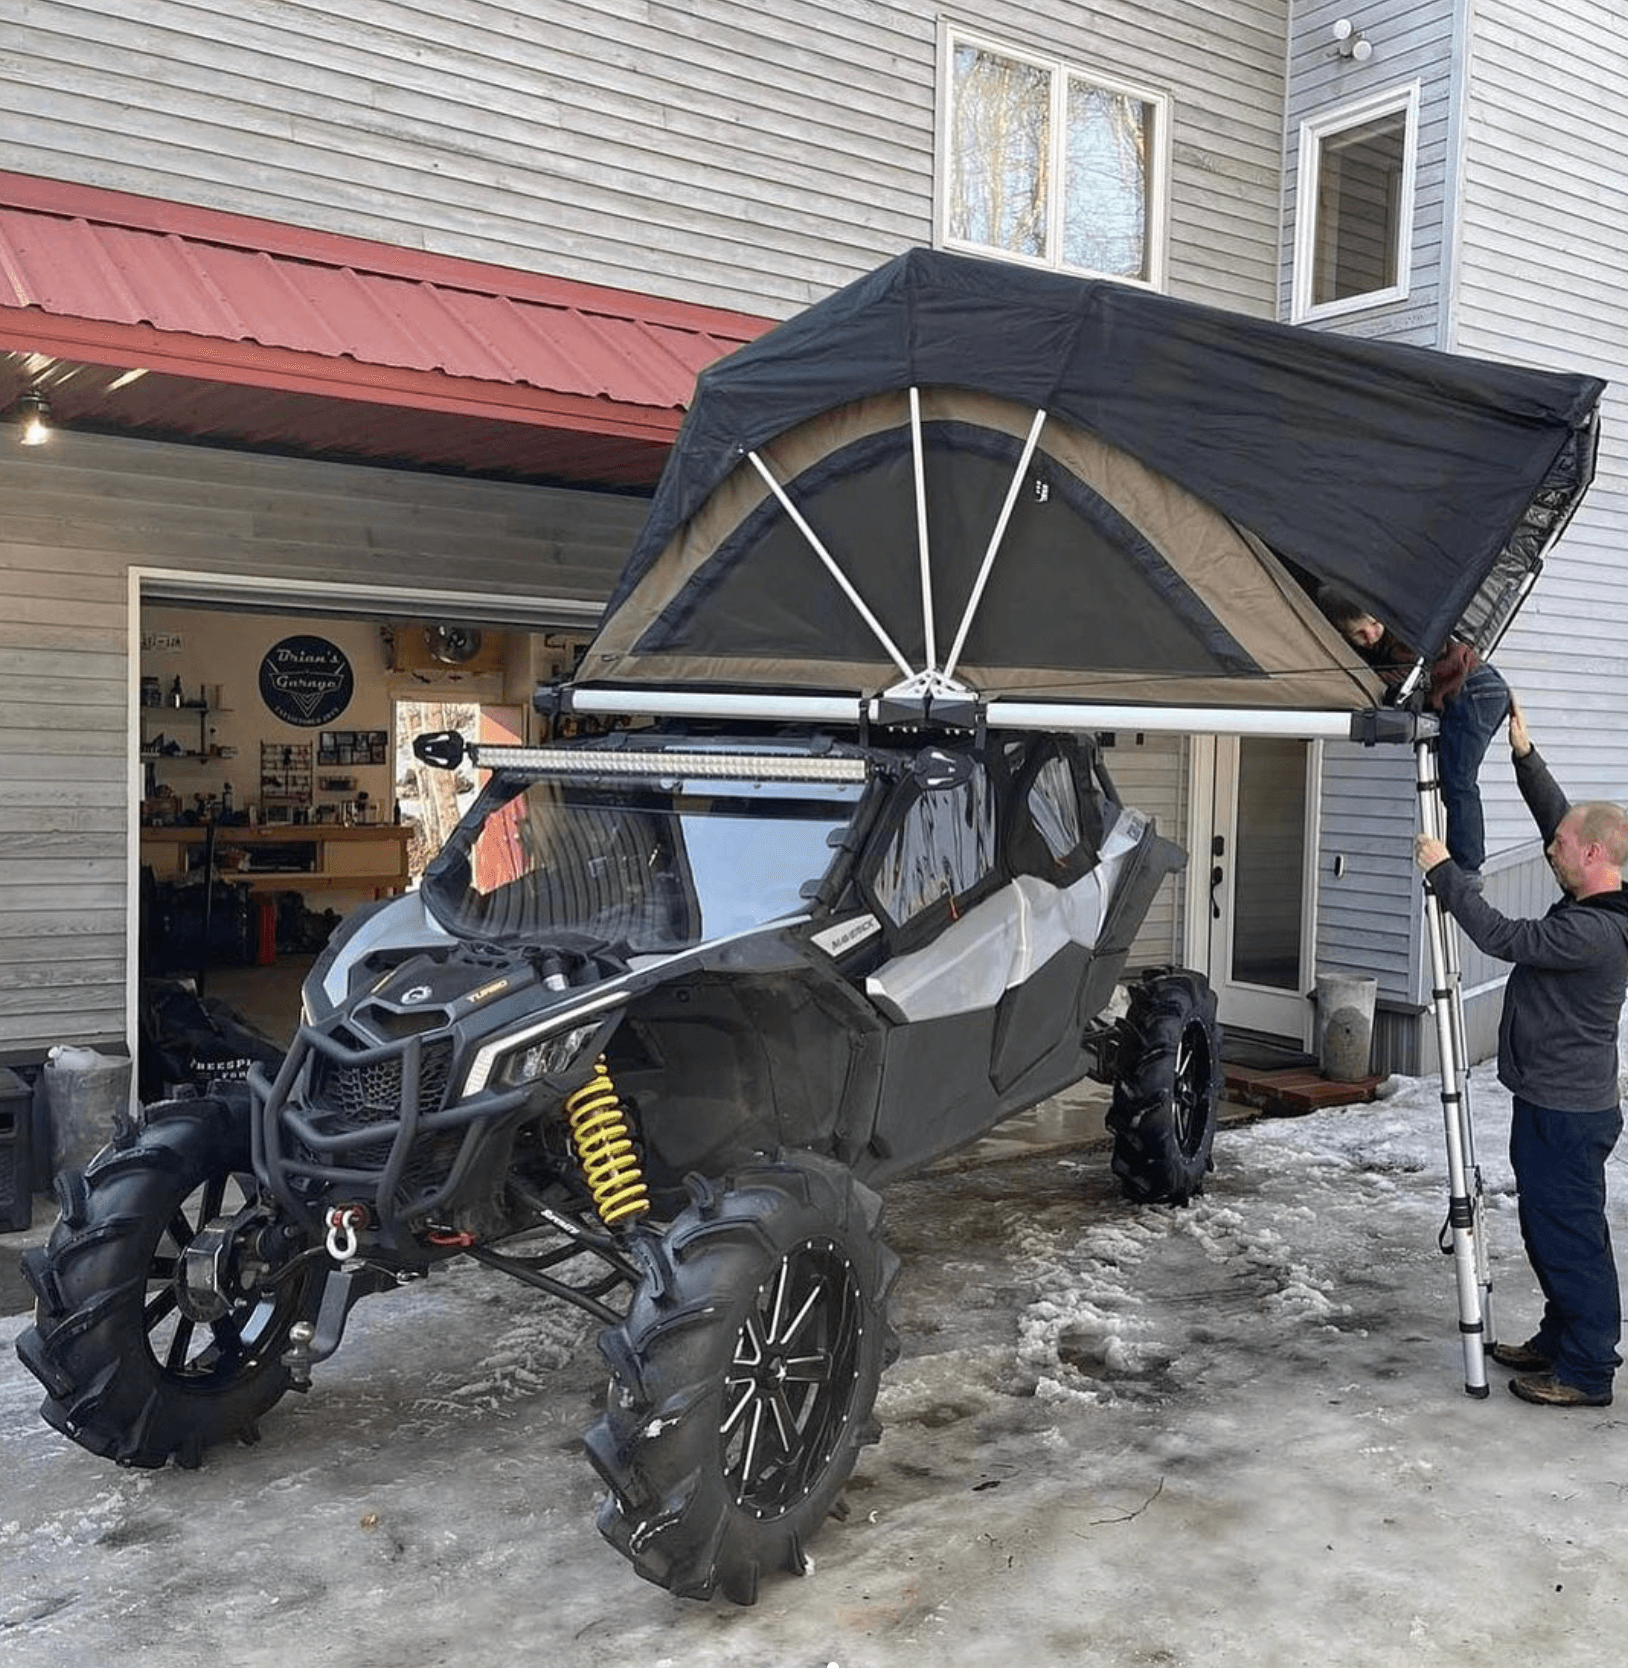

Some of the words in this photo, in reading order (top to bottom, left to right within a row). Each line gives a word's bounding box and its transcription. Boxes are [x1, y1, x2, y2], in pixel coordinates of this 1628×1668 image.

[276, 648, 339, 663] Brian's
[276, 675, 336, 691] Garage
[465, 979, 508, 1003] TURBO
